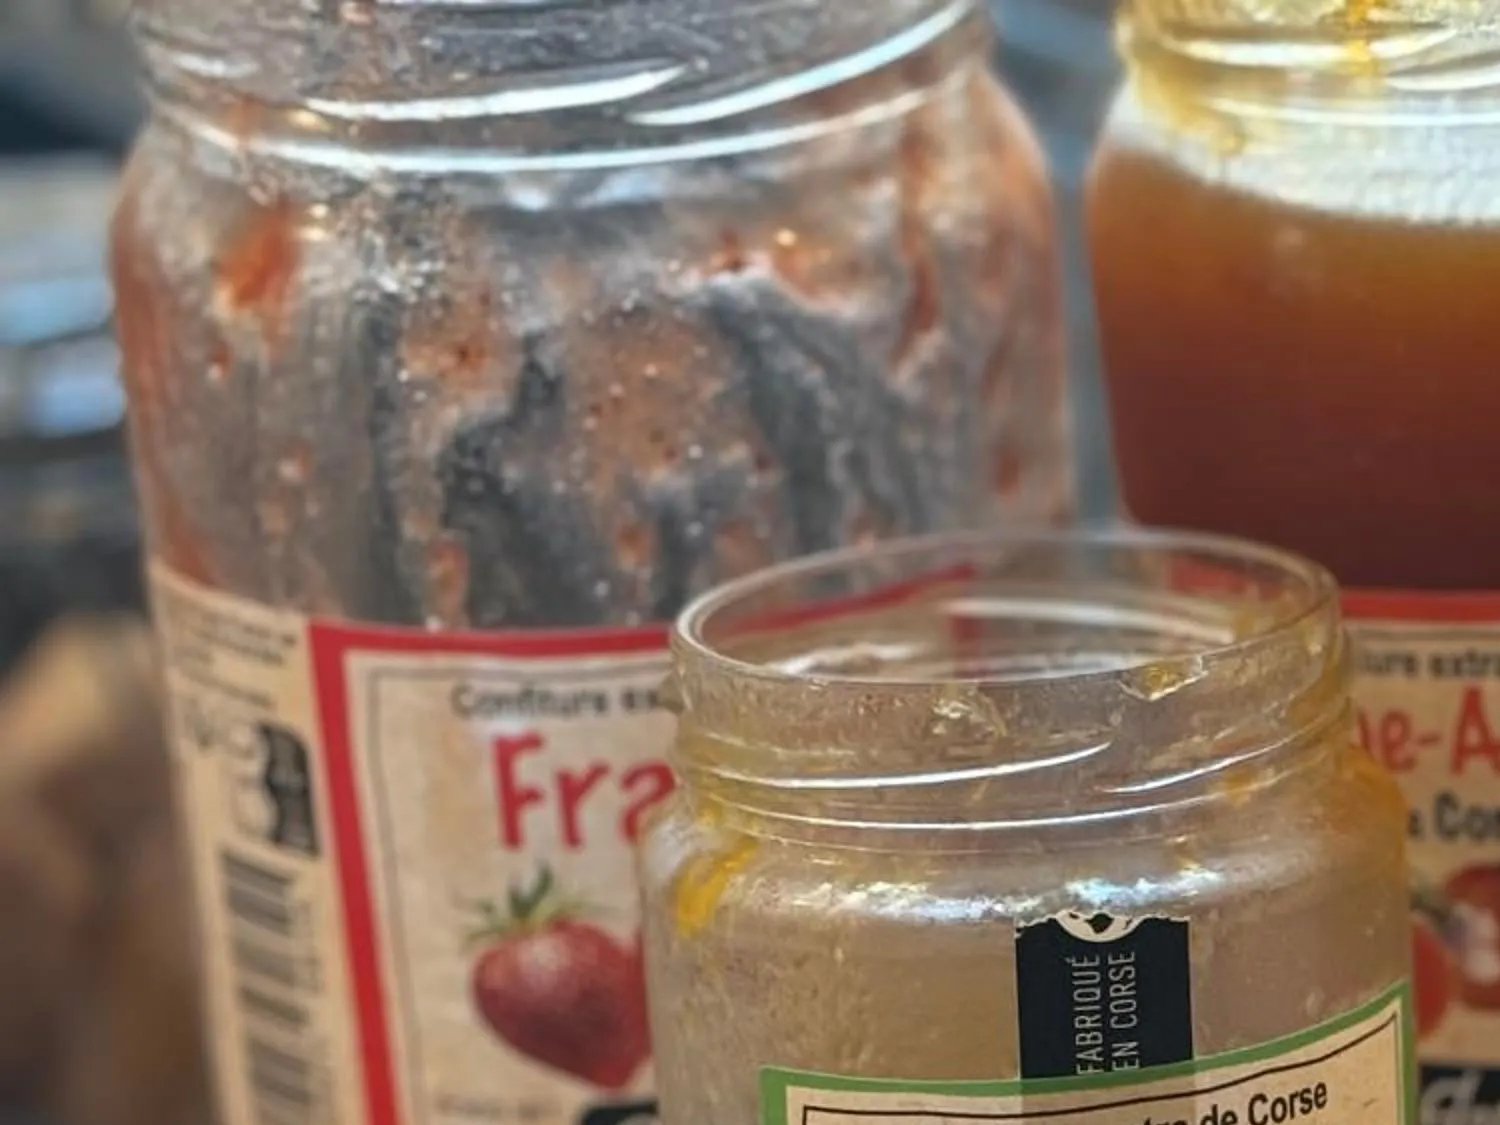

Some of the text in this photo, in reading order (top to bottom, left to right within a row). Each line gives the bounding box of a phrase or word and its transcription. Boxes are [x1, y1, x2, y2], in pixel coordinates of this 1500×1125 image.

[493, 730, 678, 852] Fra
[1065, 953, 1105, 1075] FABRIQUÉ
[1107, 951, 1140, 1071] EN CORSE
